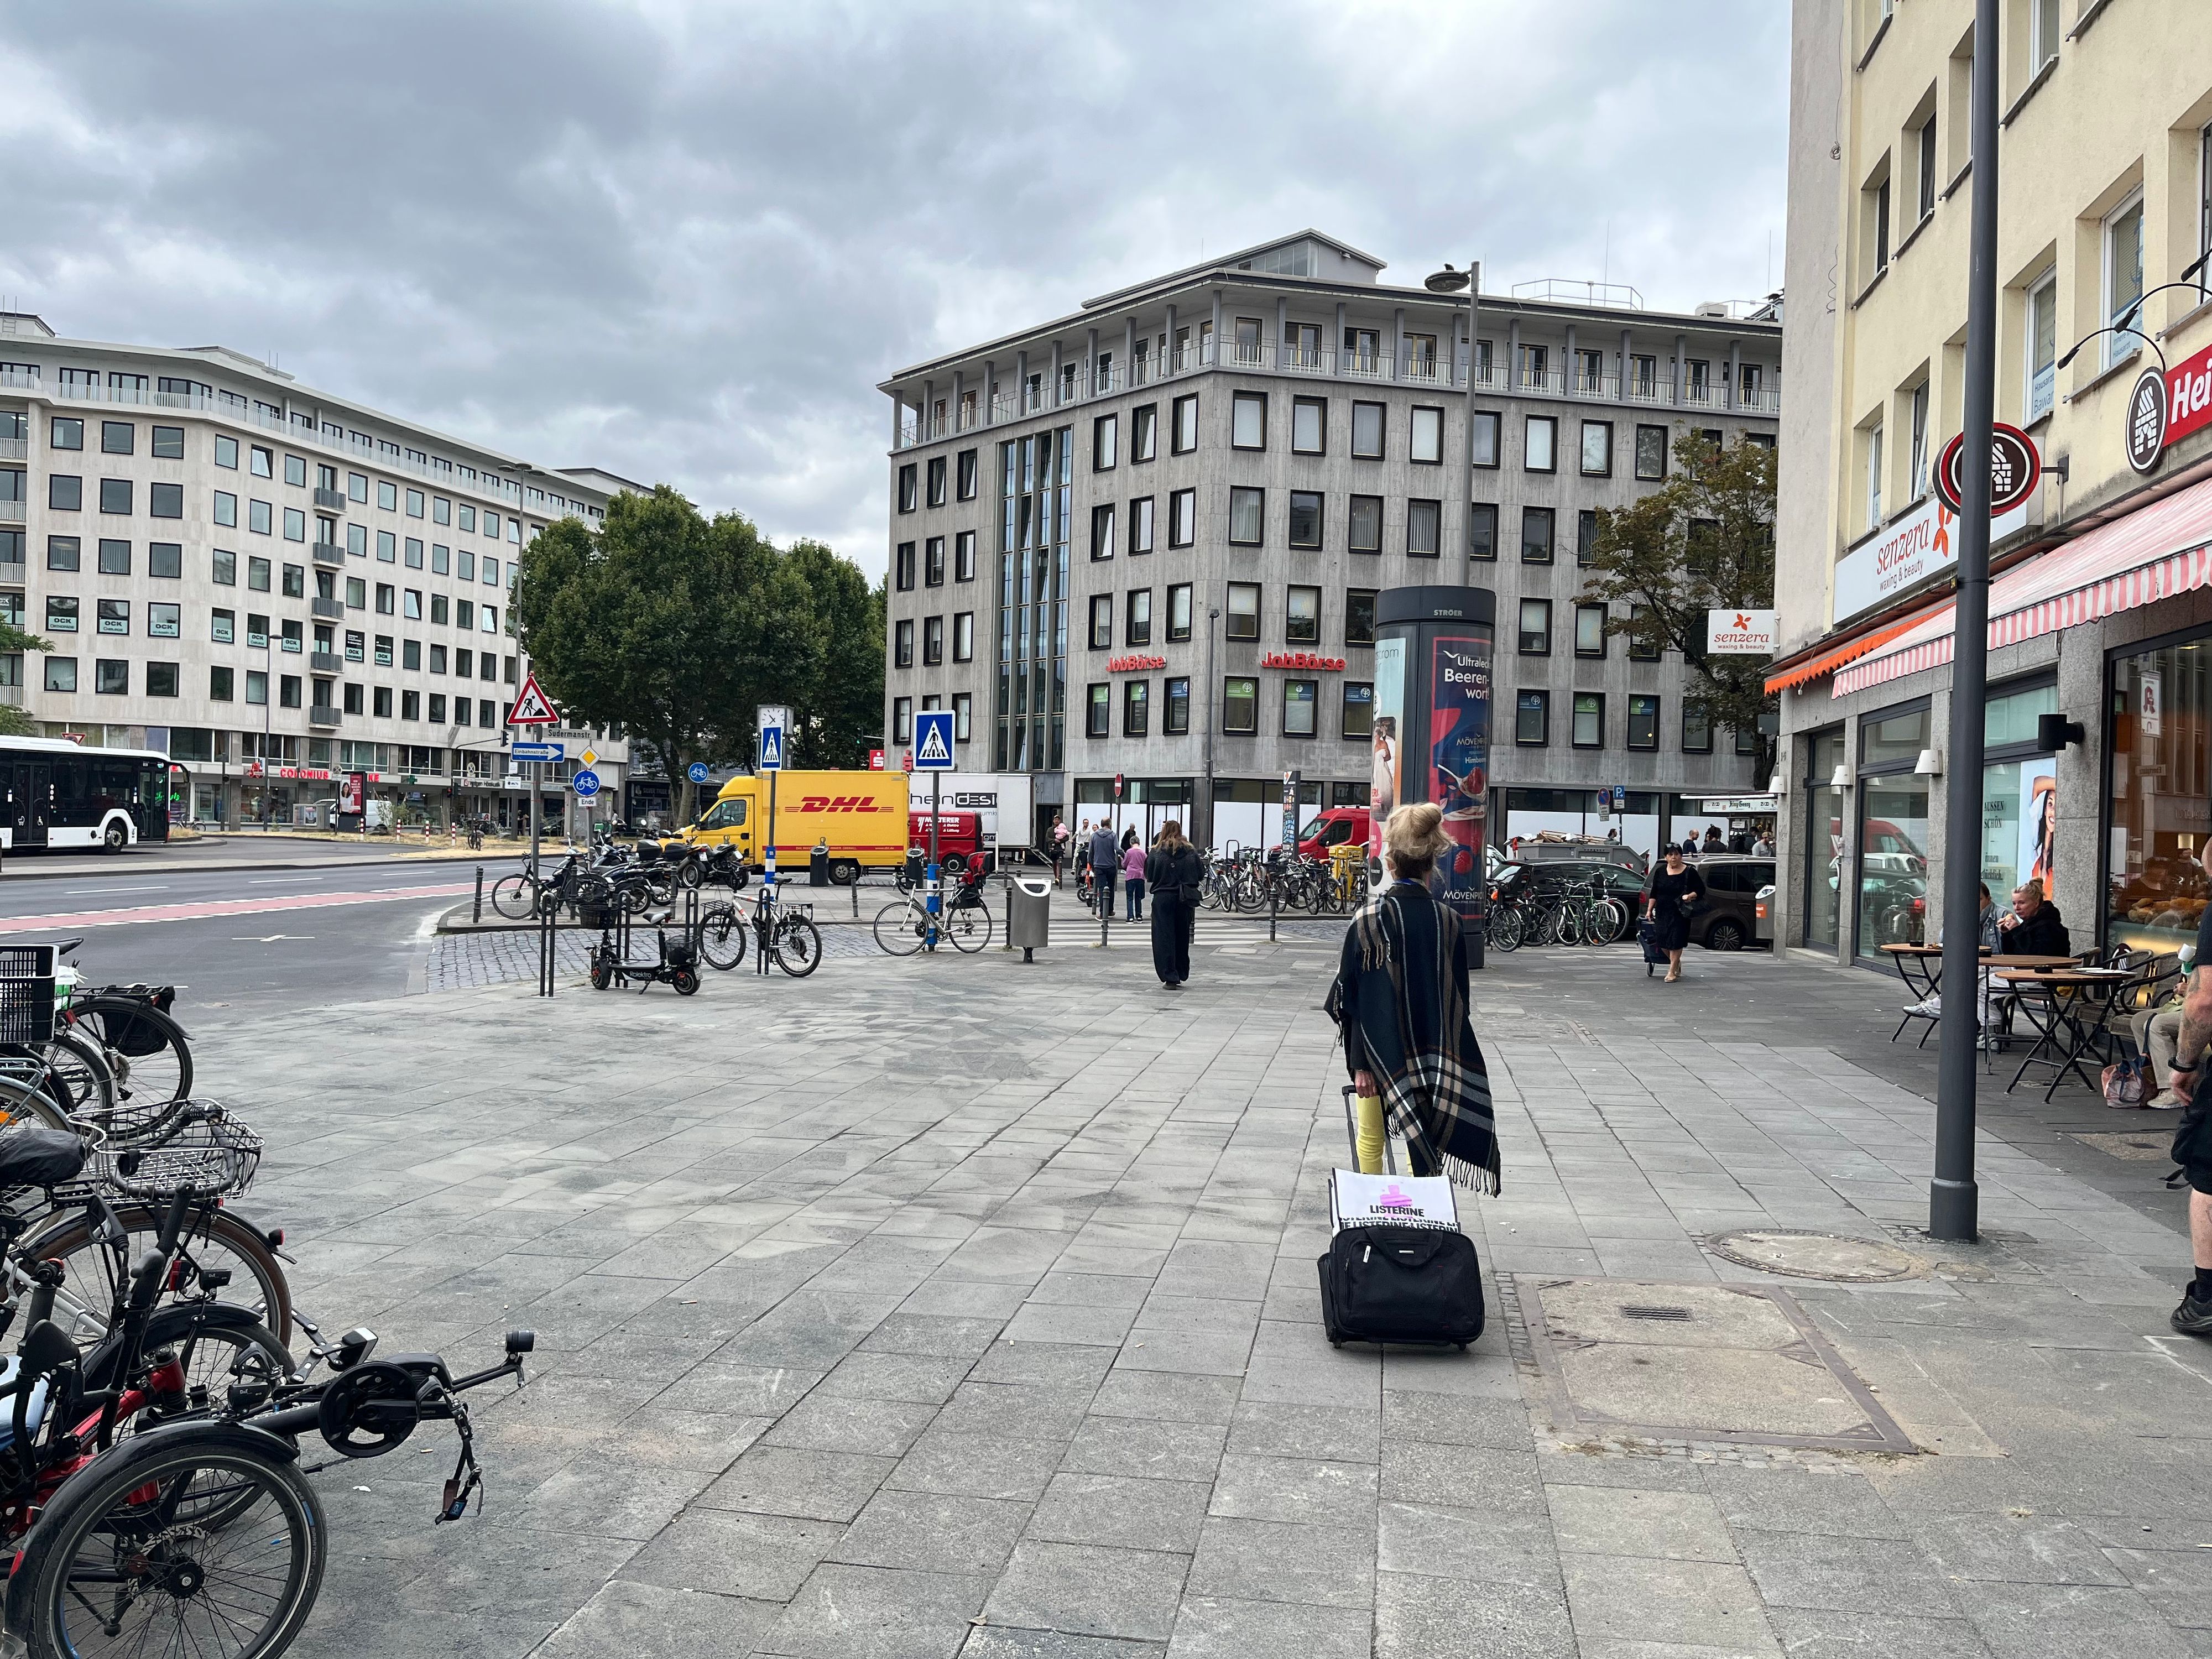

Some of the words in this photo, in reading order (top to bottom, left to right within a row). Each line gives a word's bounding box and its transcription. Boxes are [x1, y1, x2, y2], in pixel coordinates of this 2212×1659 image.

[2171, 358, 2212, 425] Hei
[1877, 518, 1930, 575] senzera
[1880, 573, 1897, 592] waxing
[1898, 567, 1902, 581] &
[1904, 559, 1924, 578] beauty
[1714, 634, 1769, 643] senzera
[1106, 654, 1166, 672] JobBörse
[1261, 651, 1346, 671] JobBörse
[1444, 668, 1490, 685] Beeren-
[549, 729, 592, 739] Sudermanstr.
[800, 796, 879, 812] DHL
[1984, 801, 2005, 812] AUSSEN
[1984, 816, 2002, 828] SCHÖN
[1985, 852, 1999, 863] innen
[1443, 889, 1485, 900] MÖVENPIC
[1370, 1204, 1425, 1217] LISTERINE
[277, 1468, 304, 1501] SCHWALBE
